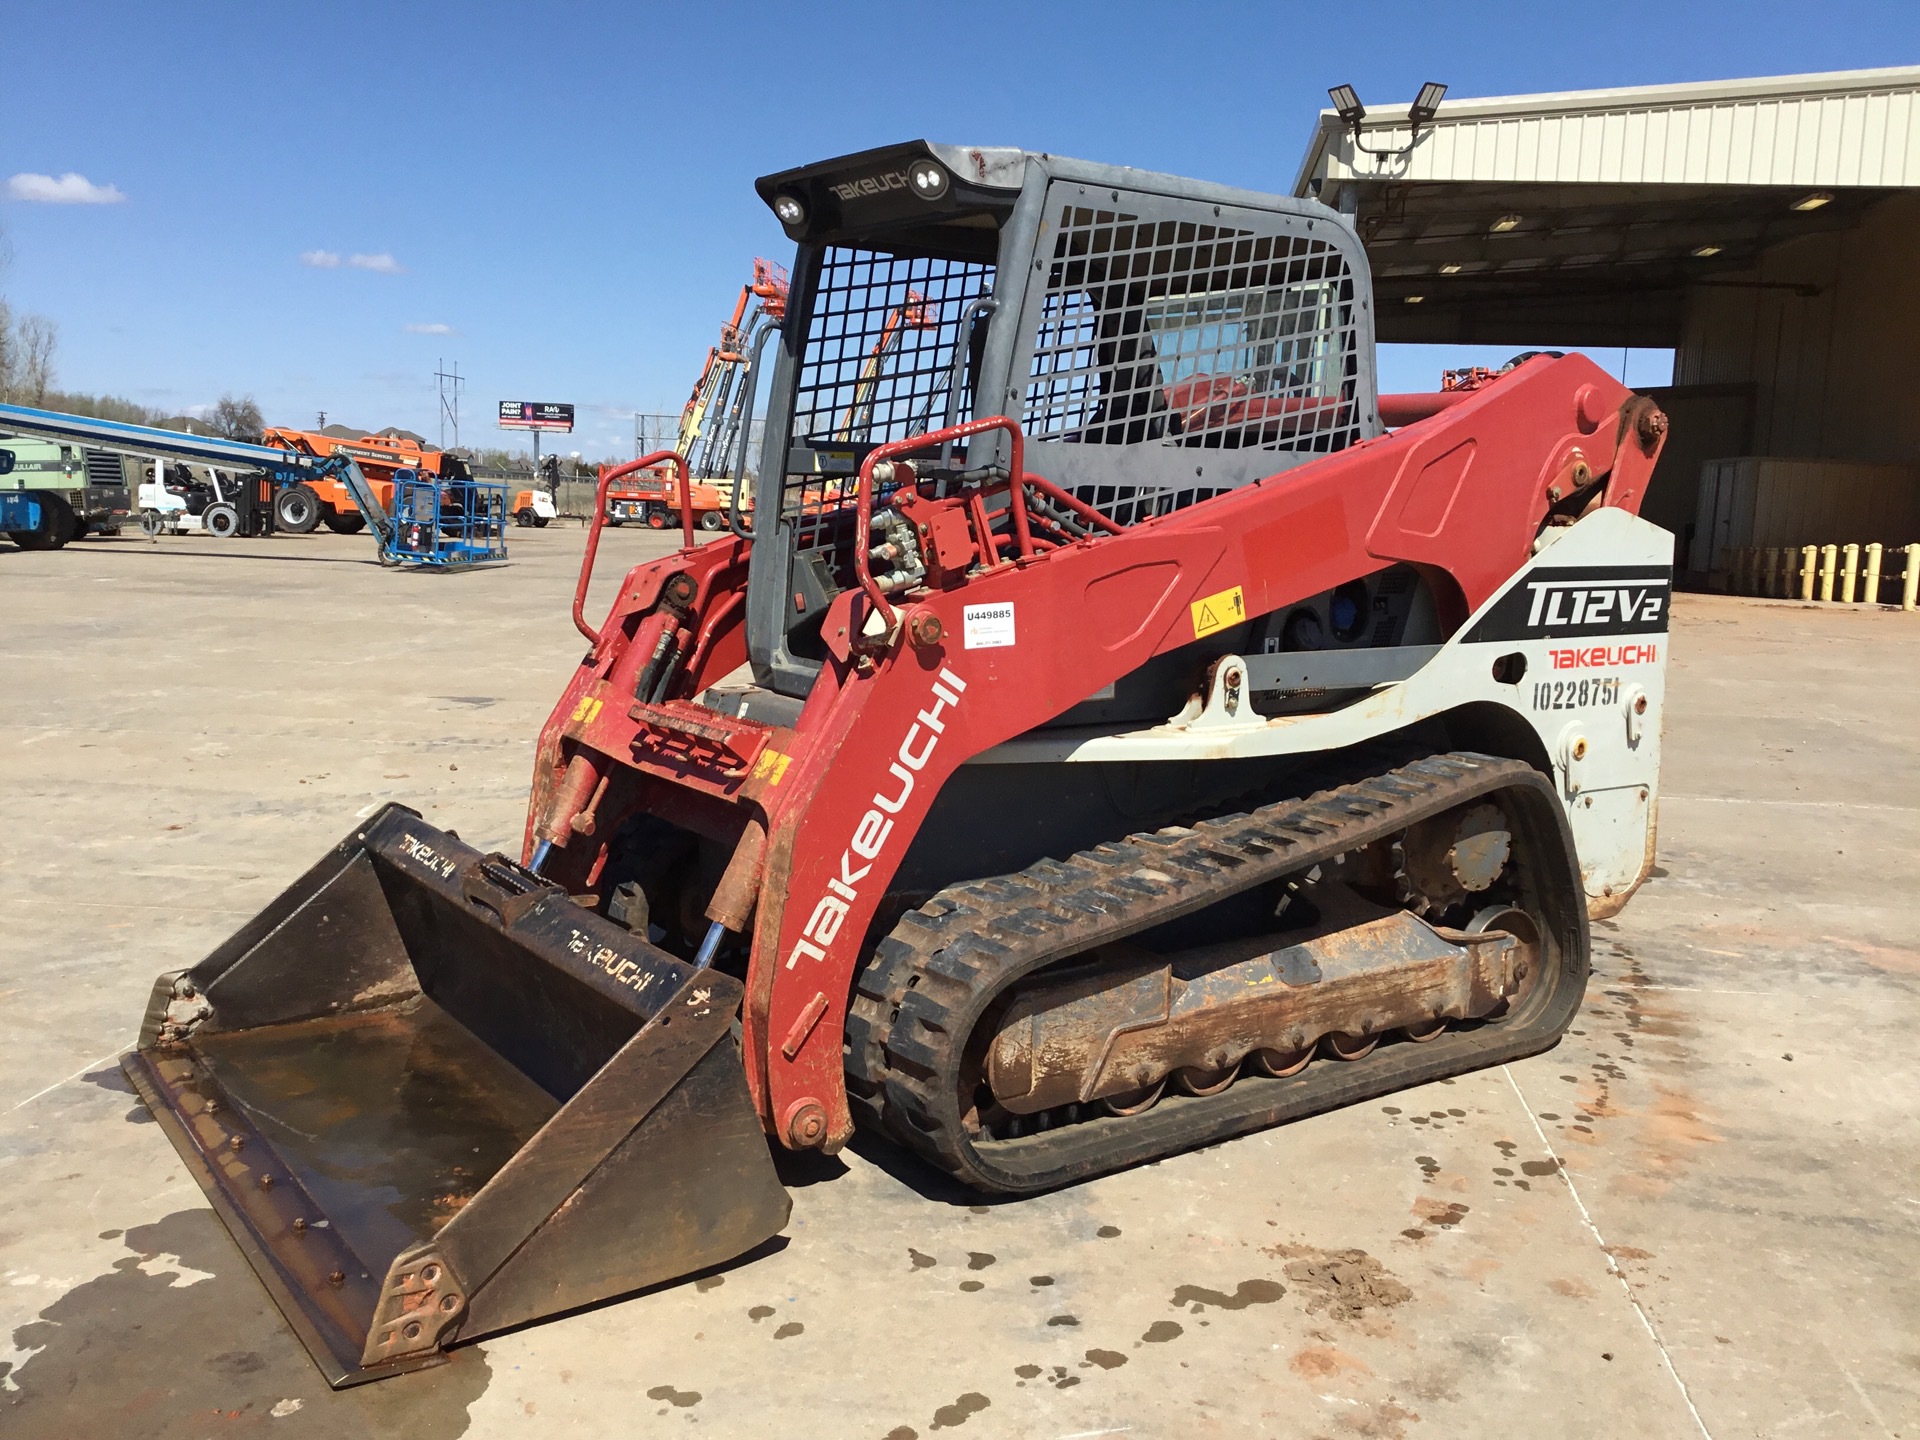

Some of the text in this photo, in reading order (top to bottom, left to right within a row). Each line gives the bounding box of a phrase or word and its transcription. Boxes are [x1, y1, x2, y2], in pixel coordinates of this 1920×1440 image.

[828, 169, 909, 201] TAKEUCH
[967, 609, 1011, 621] U449885
[1527, 578, 1669, 627] TL12V2
[1548, 645, 1656, 669] TAKEUCHI
[1532, 677, 1619, 711] 10228751
[785, 667, 967, 970] TAKEUCHI
